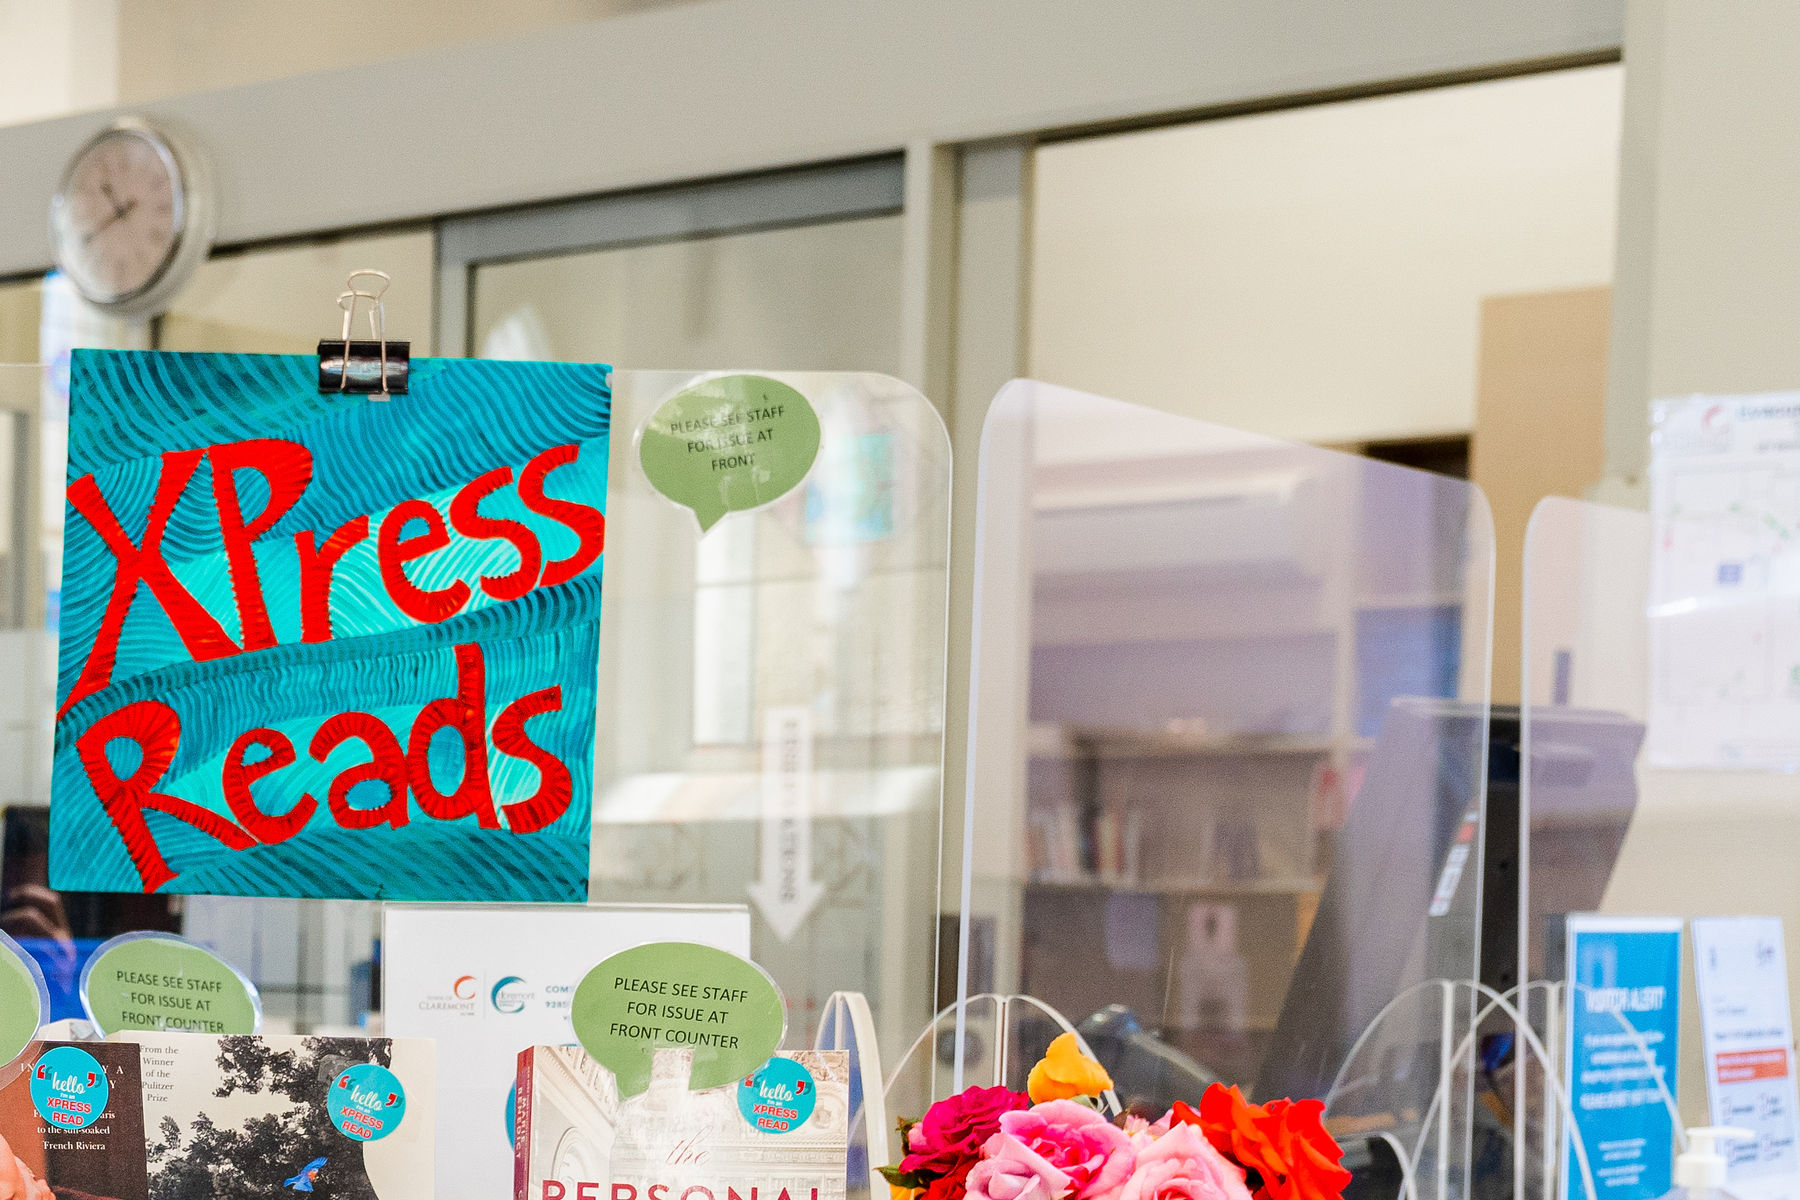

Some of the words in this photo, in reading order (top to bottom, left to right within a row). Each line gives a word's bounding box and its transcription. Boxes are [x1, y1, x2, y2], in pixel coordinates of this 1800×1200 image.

[747, 406, 785, 423] STAFF
[712, 454, 755, 471] FRONT
[56, 438, 605, 721] XPress
[76, 643, 572, 894] Reads
[117, 971, 159, 987] PLEASE
[163, 975, 183, 989] SEE
[186, 977, 222, 993] STAFF
[614, 977, 668, 995] PLEASE
[671, 984, 698, 998] SEE
[703, 986, 748, 1003] STAFF
[131, 992, 156, 1006] FOR
[160, 995, 192, 1010] ISSUE
[122, 1011, 162, 1026] FRONT
[166, 1015, 225, 1033] COUNTER
[627, 1001, 657, 1017] FOR
[661, 1004, 703, 1022] ISSUE
[708, 1010, 728, 1024] AT
[610, 1023, 661, 1042] FRONT
[665, 1029, 739, 1049] COUNTER
[52, 1071, 86, 1094] hello
[760, 1080, 793, 1102] hello
[47, 1097, 92, 1113] XPRESS
[147, 1094, 168, 1102] Prize
[350, 1084, 382, 1111] hello
[51, 1112, 84, 1126] READ
[340, 1106, 383, 1130] XPRESS
[753, 1104, 798, 1120] XPRESS
[341, 1120, 372, 1139] READ
[758, 1118, 789, 1131] READ
